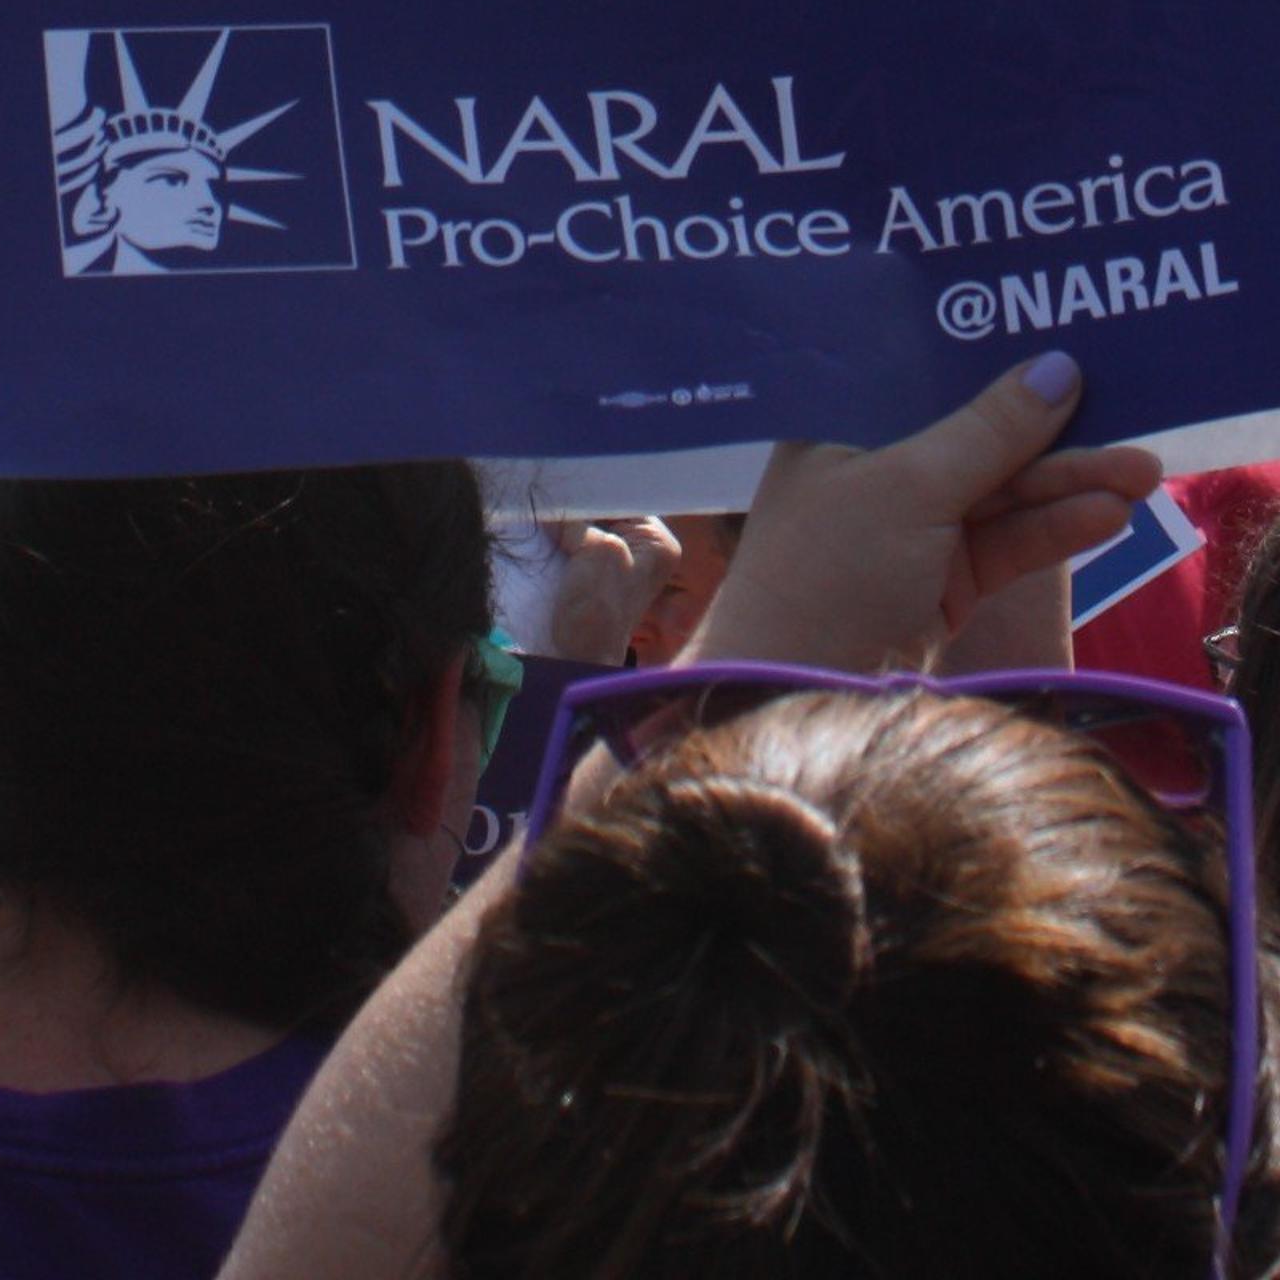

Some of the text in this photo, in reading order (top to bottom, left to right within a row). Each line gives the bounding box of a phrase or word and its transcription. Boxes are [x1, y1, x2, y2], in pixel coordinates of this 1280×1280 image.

[366, 76, 846, 186] NARAL
[384, 156, 1230, 269] Pro-Choice America
[935, 243, 1240, 340] @NARAL
